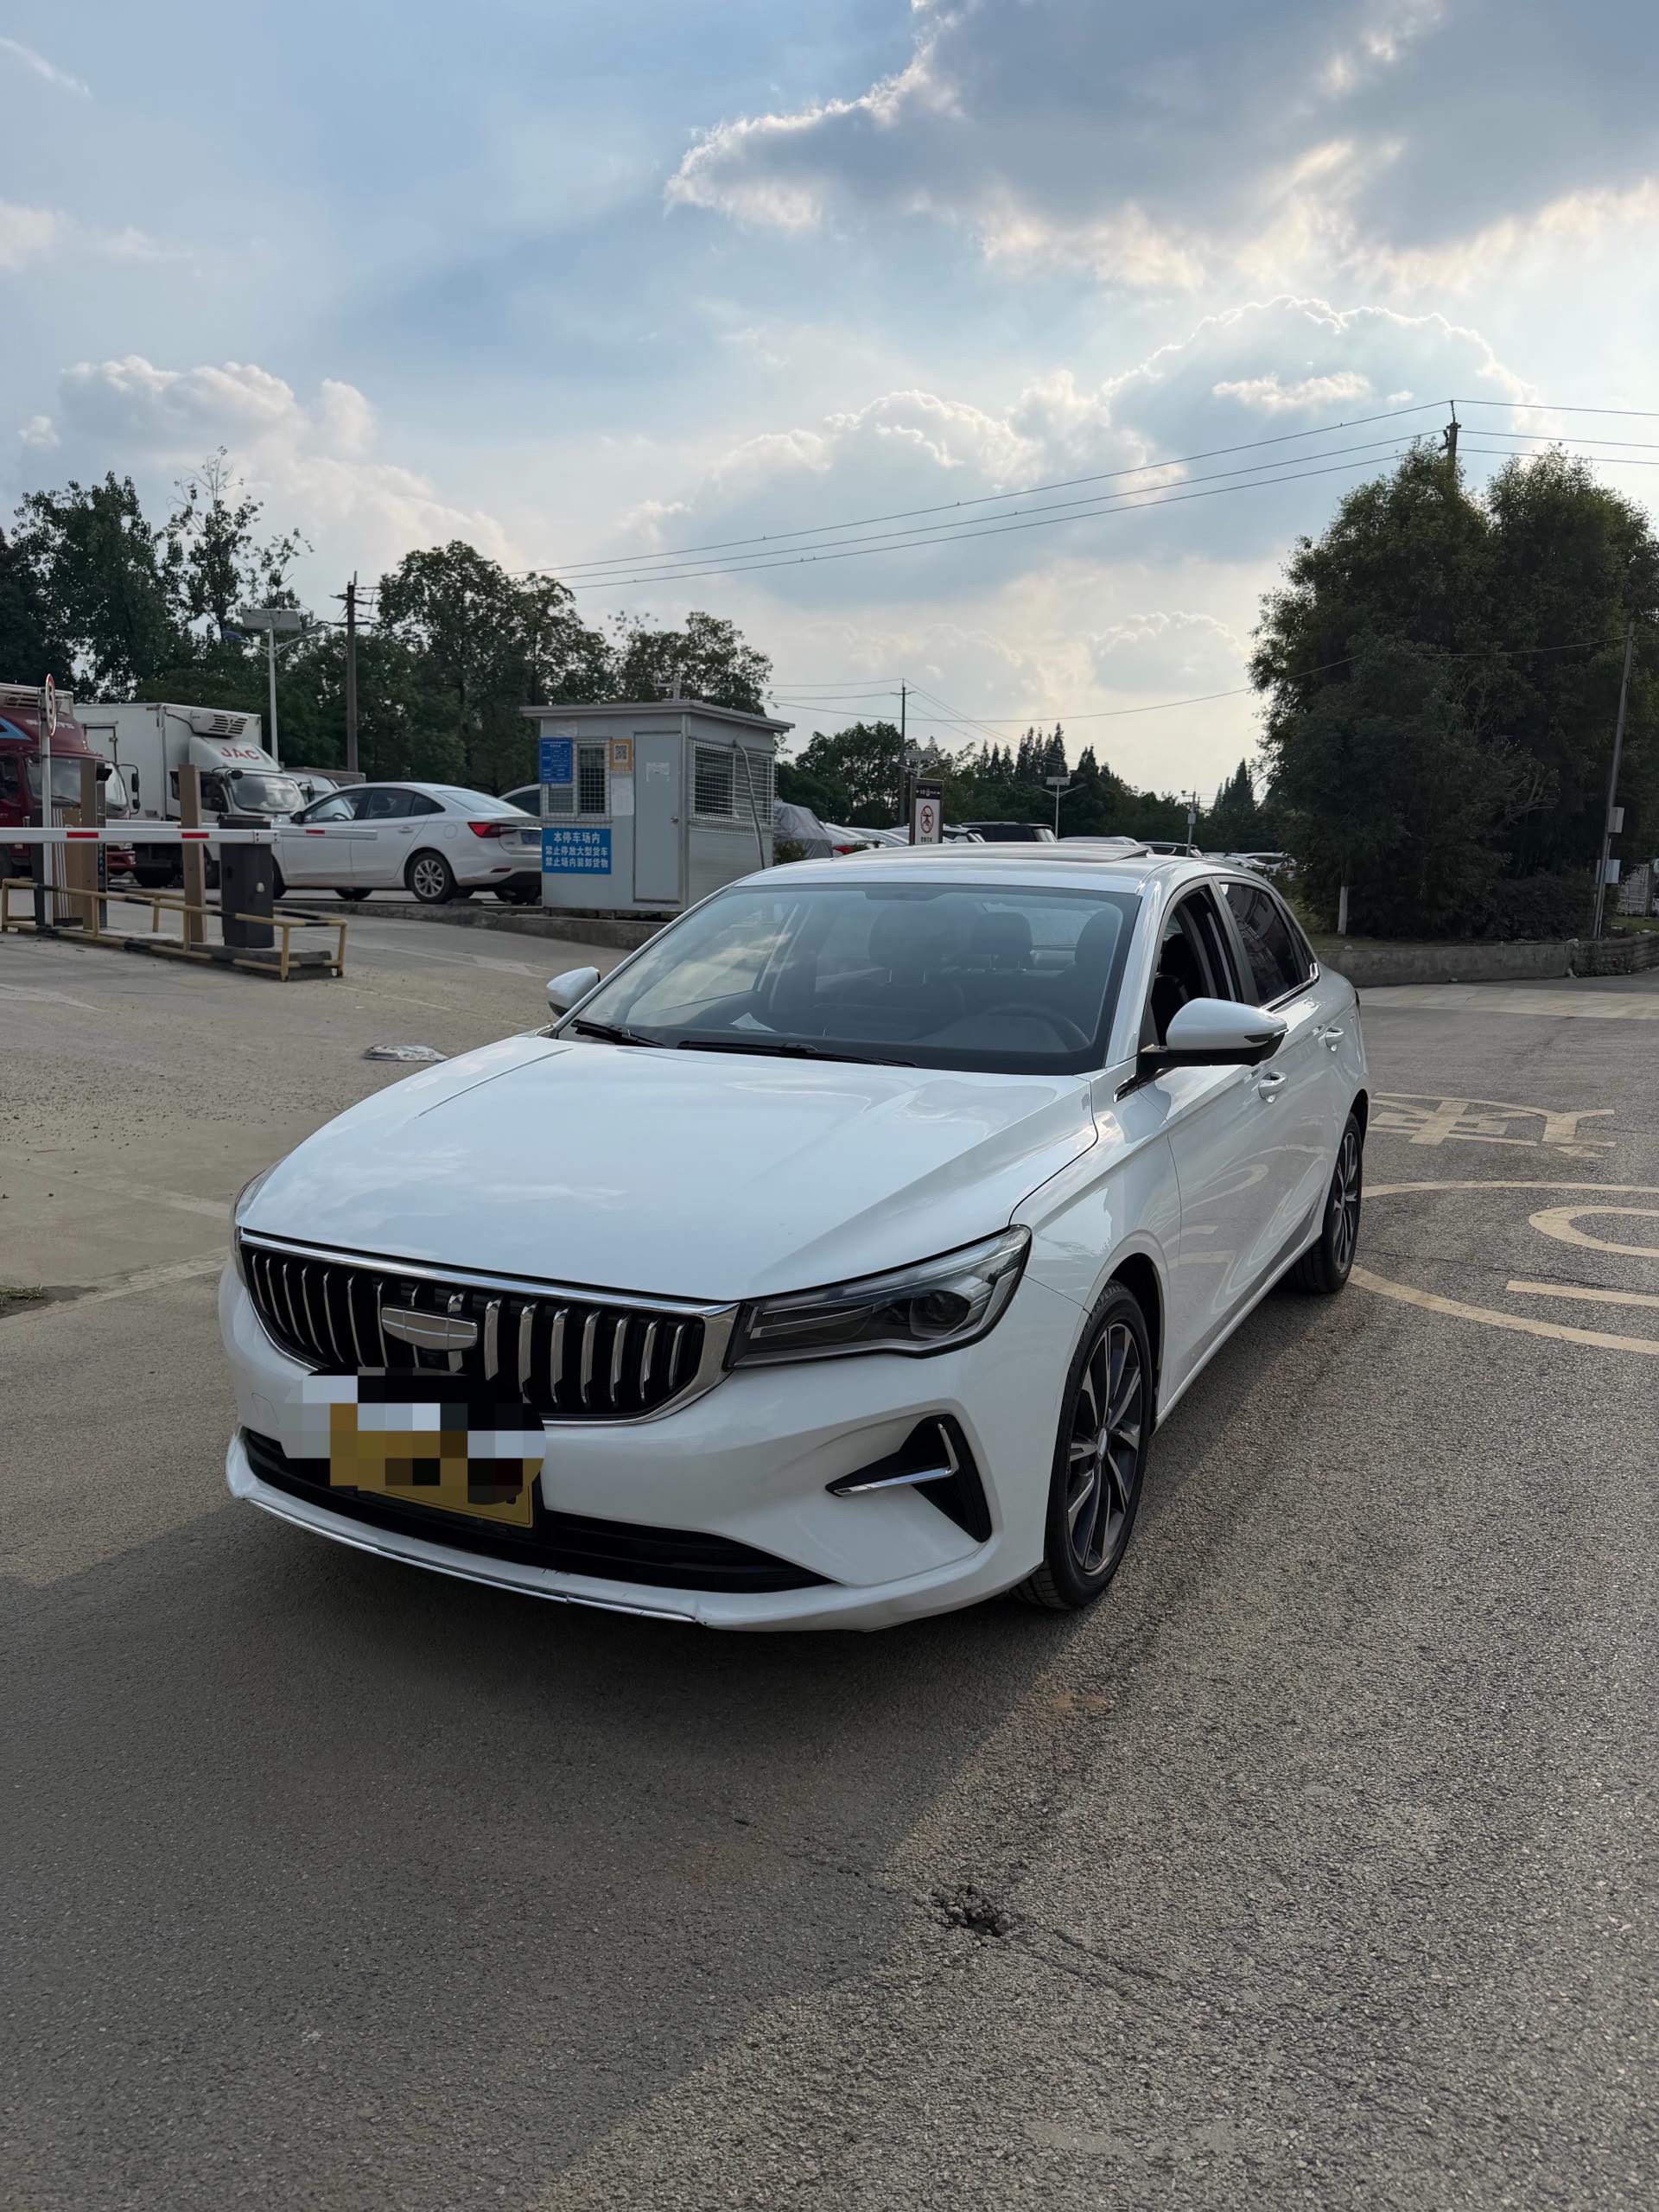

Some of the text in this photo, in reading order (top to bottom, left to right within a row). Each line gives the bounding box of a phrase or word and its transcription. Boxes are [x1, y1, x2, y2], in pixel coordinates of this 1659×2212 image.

[221, 747, 260, 760] JAC
[553, 831, 601, 844] 本停车场内
[545, 845, 608, 857] 禁止停放大型货车
[545, 856, 608, 868] 禁止场内装卸货物
